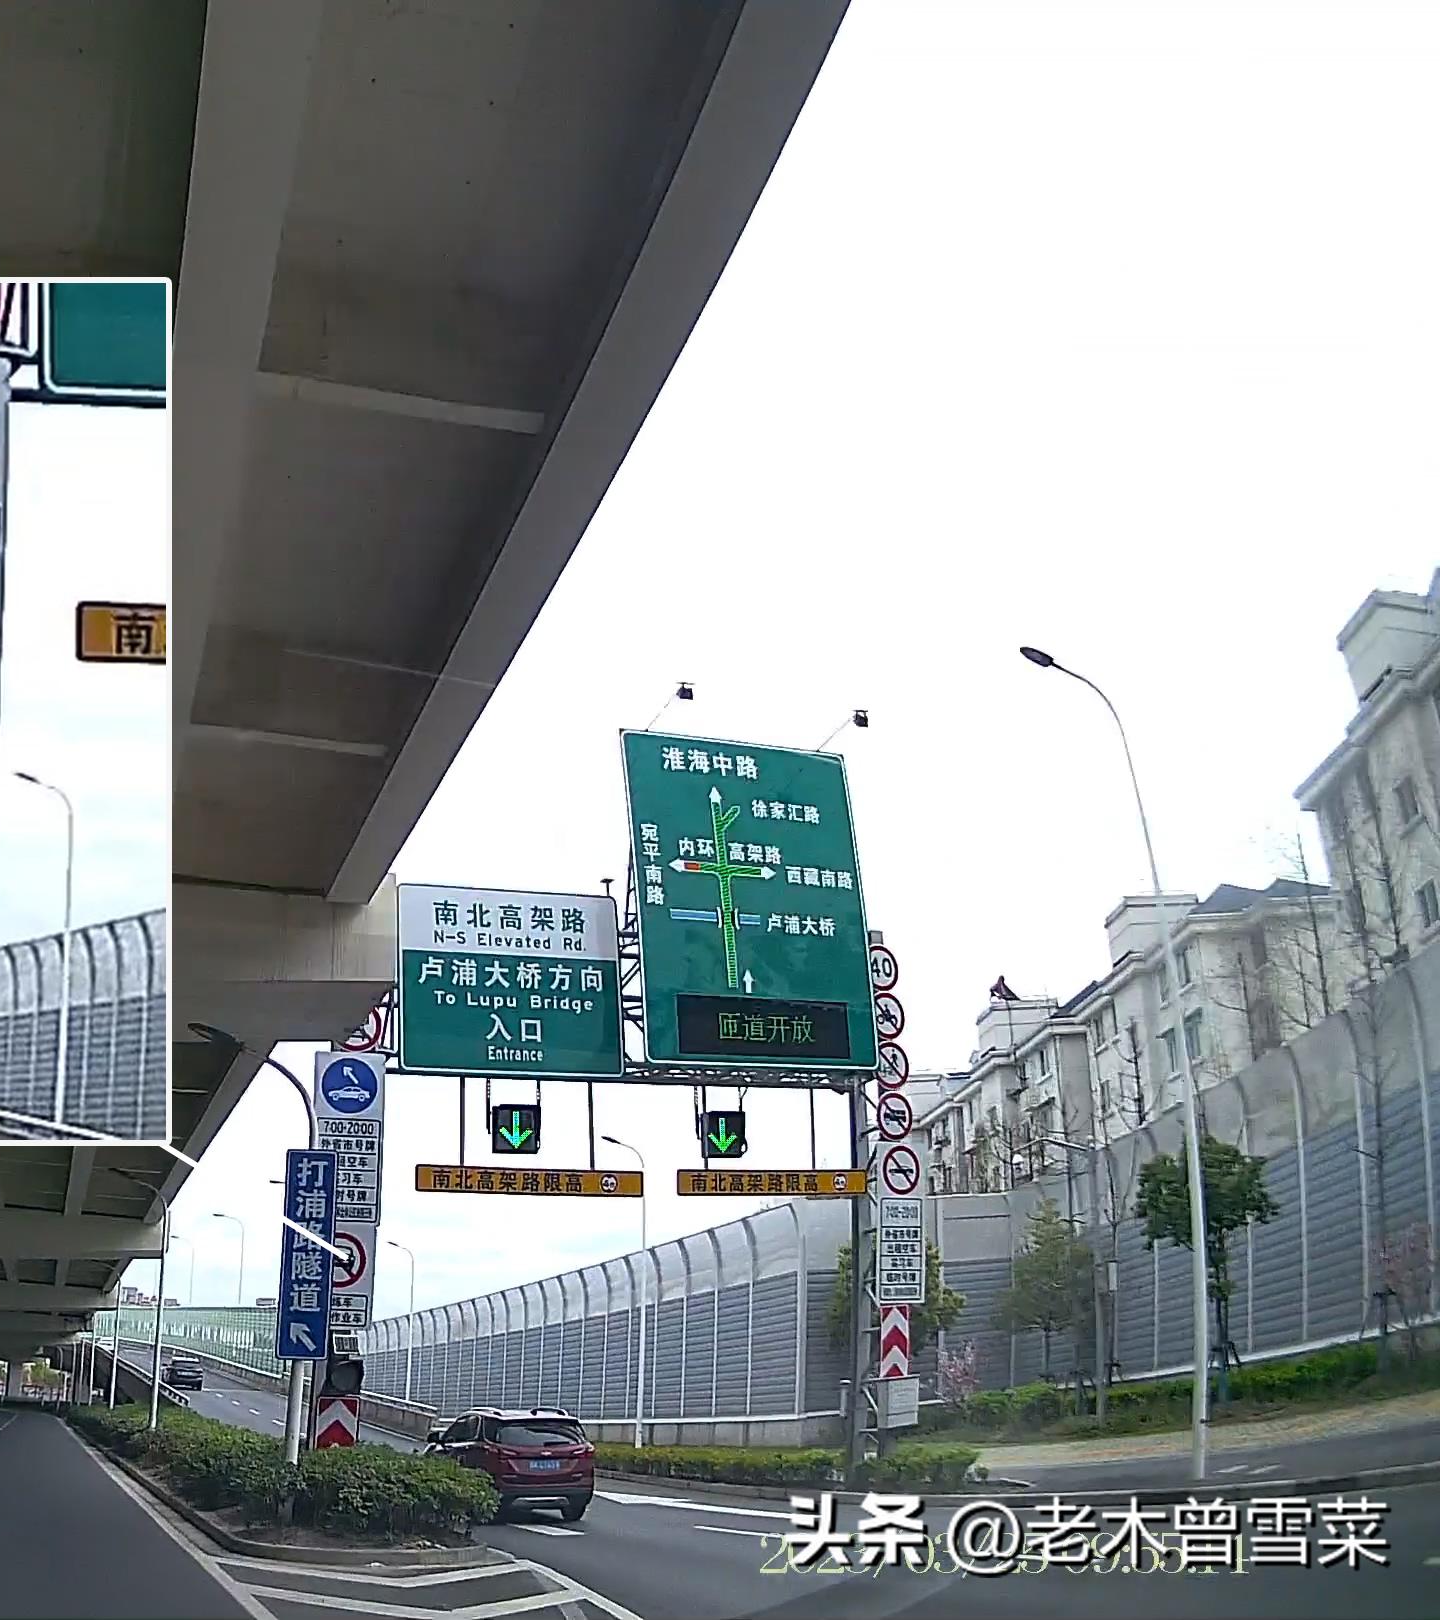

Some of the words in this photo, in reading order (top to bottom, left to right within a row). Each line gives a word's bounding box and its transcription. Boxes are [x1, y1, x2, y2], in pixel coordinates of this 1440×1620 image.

[662, 747, 758, 780] 淮海中路
[751, 799, 820, 825] 徐家汇路
[640, 823, 665, 905] 宛平南路
[678, 837, 714, 858] 内环
[728, 842, 782, 865] 高架路
[785, 865, 853, 891] 西藏南路
[433, 900, 586, 934] 南北高架路
[767, 913, 836, 937] 卢浦大桥
[433, 931, 466, 945] N-S
[477, 933, 551, 950] Elevated
[563, 937, 587, 951] Rd.
[418, 956, 604, 992] 卢浦大桥方向
[871, 957, 892, 978] 40
[433, 990, 456, 1005] To
[467, 992, 517, 1010] Lupu
[530, 995, 594, 1014] Bridge
[485, 1013, 543, 1043] 入口
[718, 1013, 816, 1043] 匝道开放
[488, 1045, 544, 1062] Entrance
[432, 1170, 583, 1193] 南北高架路限高
[690, 1173, 818, 1192] 南北高架路限高
[289, 1158, 329, 1312] 打浦路隧道
